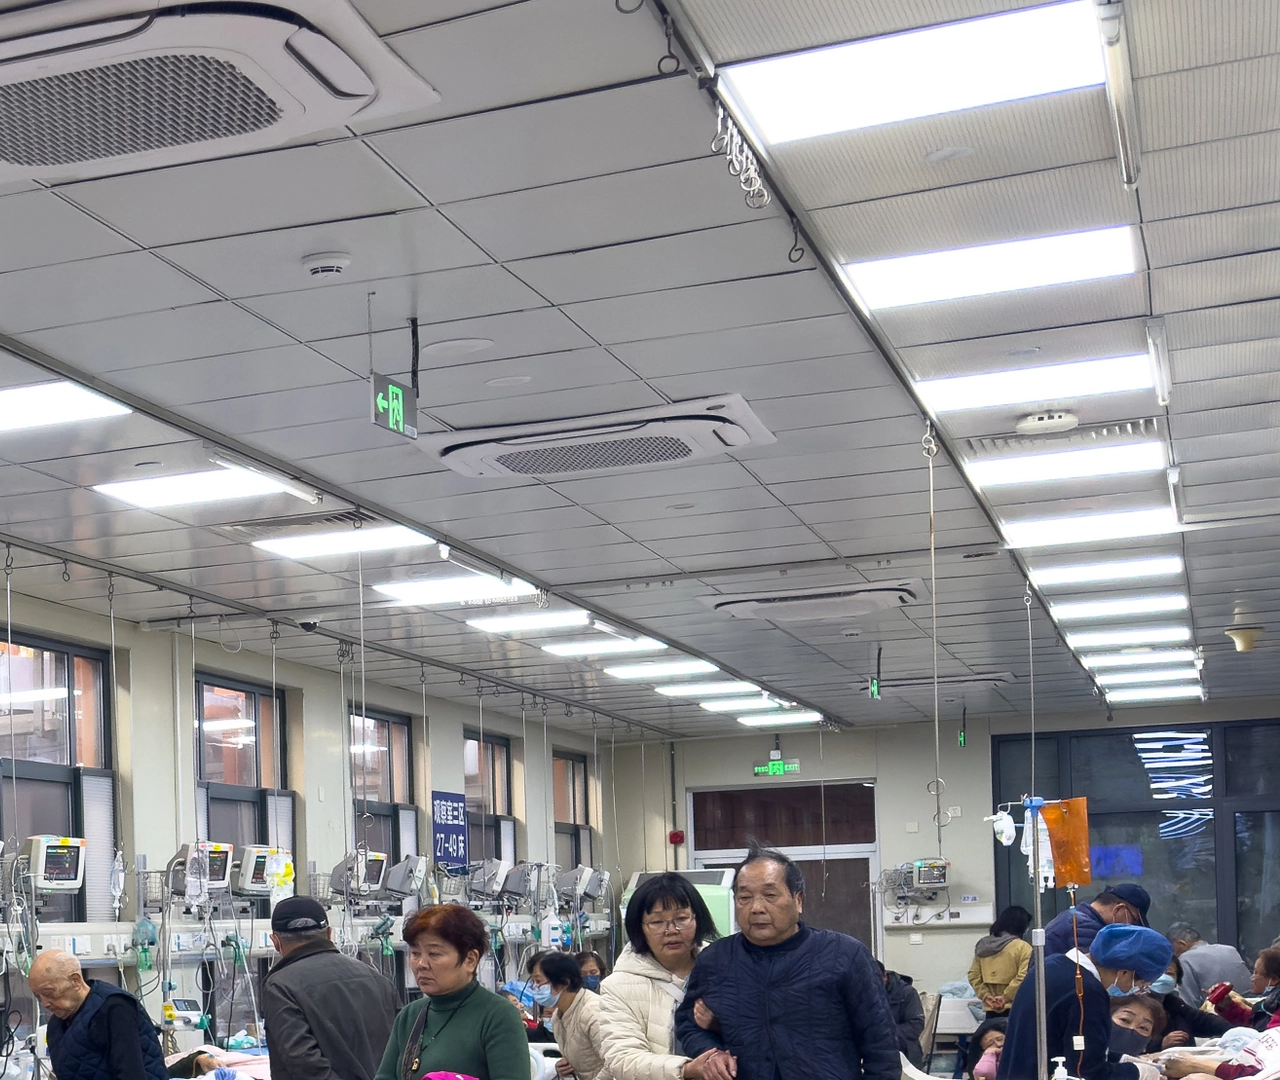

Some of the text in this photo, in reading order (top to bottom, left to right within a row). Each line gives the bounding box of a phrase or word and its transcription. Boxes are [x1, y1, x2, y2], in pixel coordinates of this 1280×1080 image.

[433, 799, 465, 826] 观察室三区
